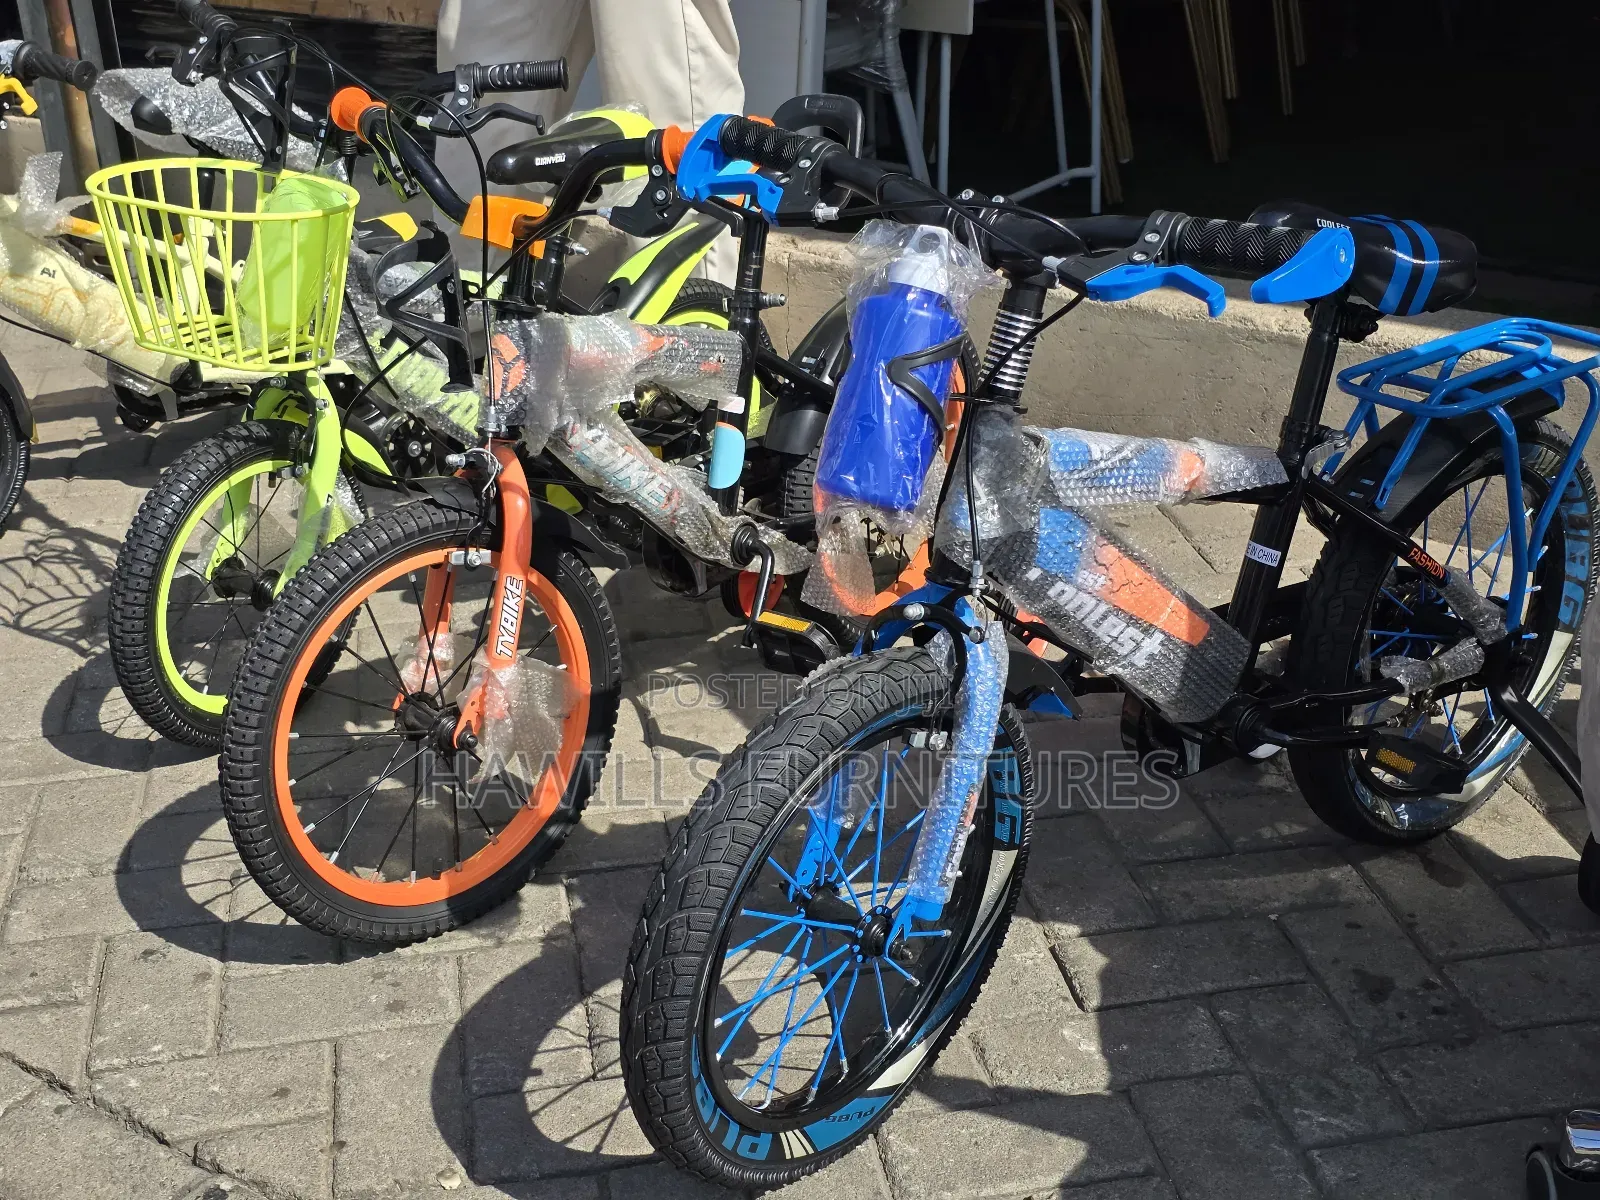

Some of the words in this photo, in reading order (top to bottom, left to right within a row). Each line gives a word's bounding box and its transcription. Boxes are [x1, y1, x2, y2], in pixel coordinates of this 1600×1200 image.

[1257, 548, 1279, 565] CHINA
[1408, 547, 1445, 579] FASHION
[496, 575, 523, 659] TYBIKE
